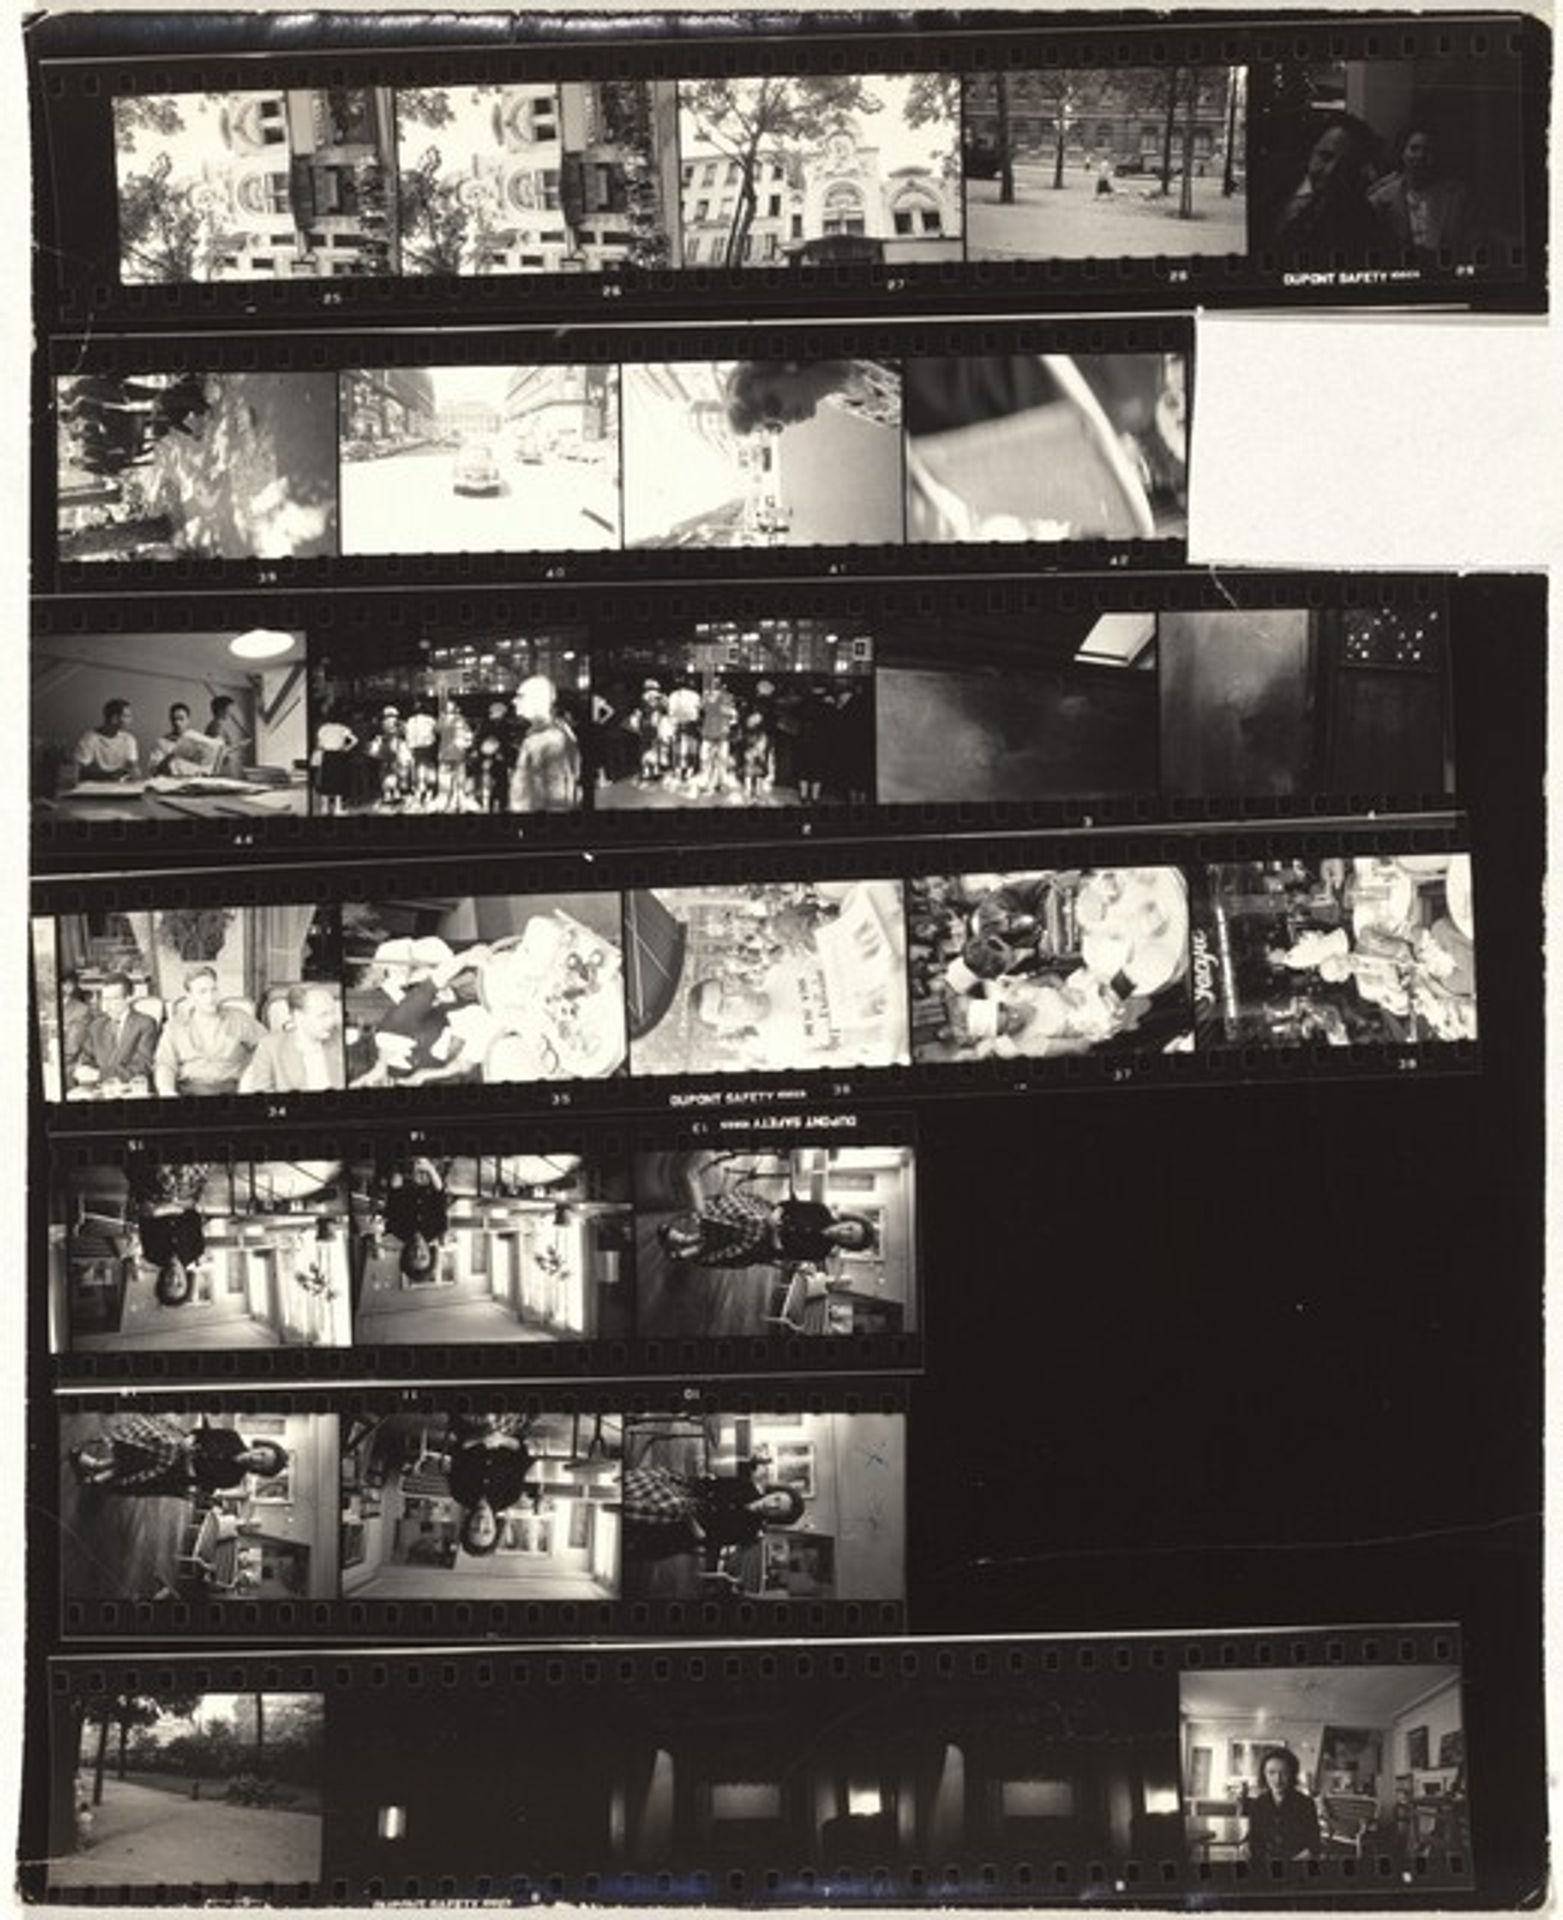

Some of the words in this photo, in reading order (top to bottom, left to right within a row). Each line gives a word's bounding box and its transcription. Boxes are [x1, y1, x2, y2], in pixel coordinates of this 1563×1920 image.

[1283, 272, 1335, 286] DUPONT
[1338, 270, 1388, 284] SAFETY
[669, 1091, 722, 1107] DUPONT
[725, 1090, 774, 1104] SAFETY
[753, 1116, 801, 1129] SAFETY
[805, 1115, 857, 1129] DUPONT
